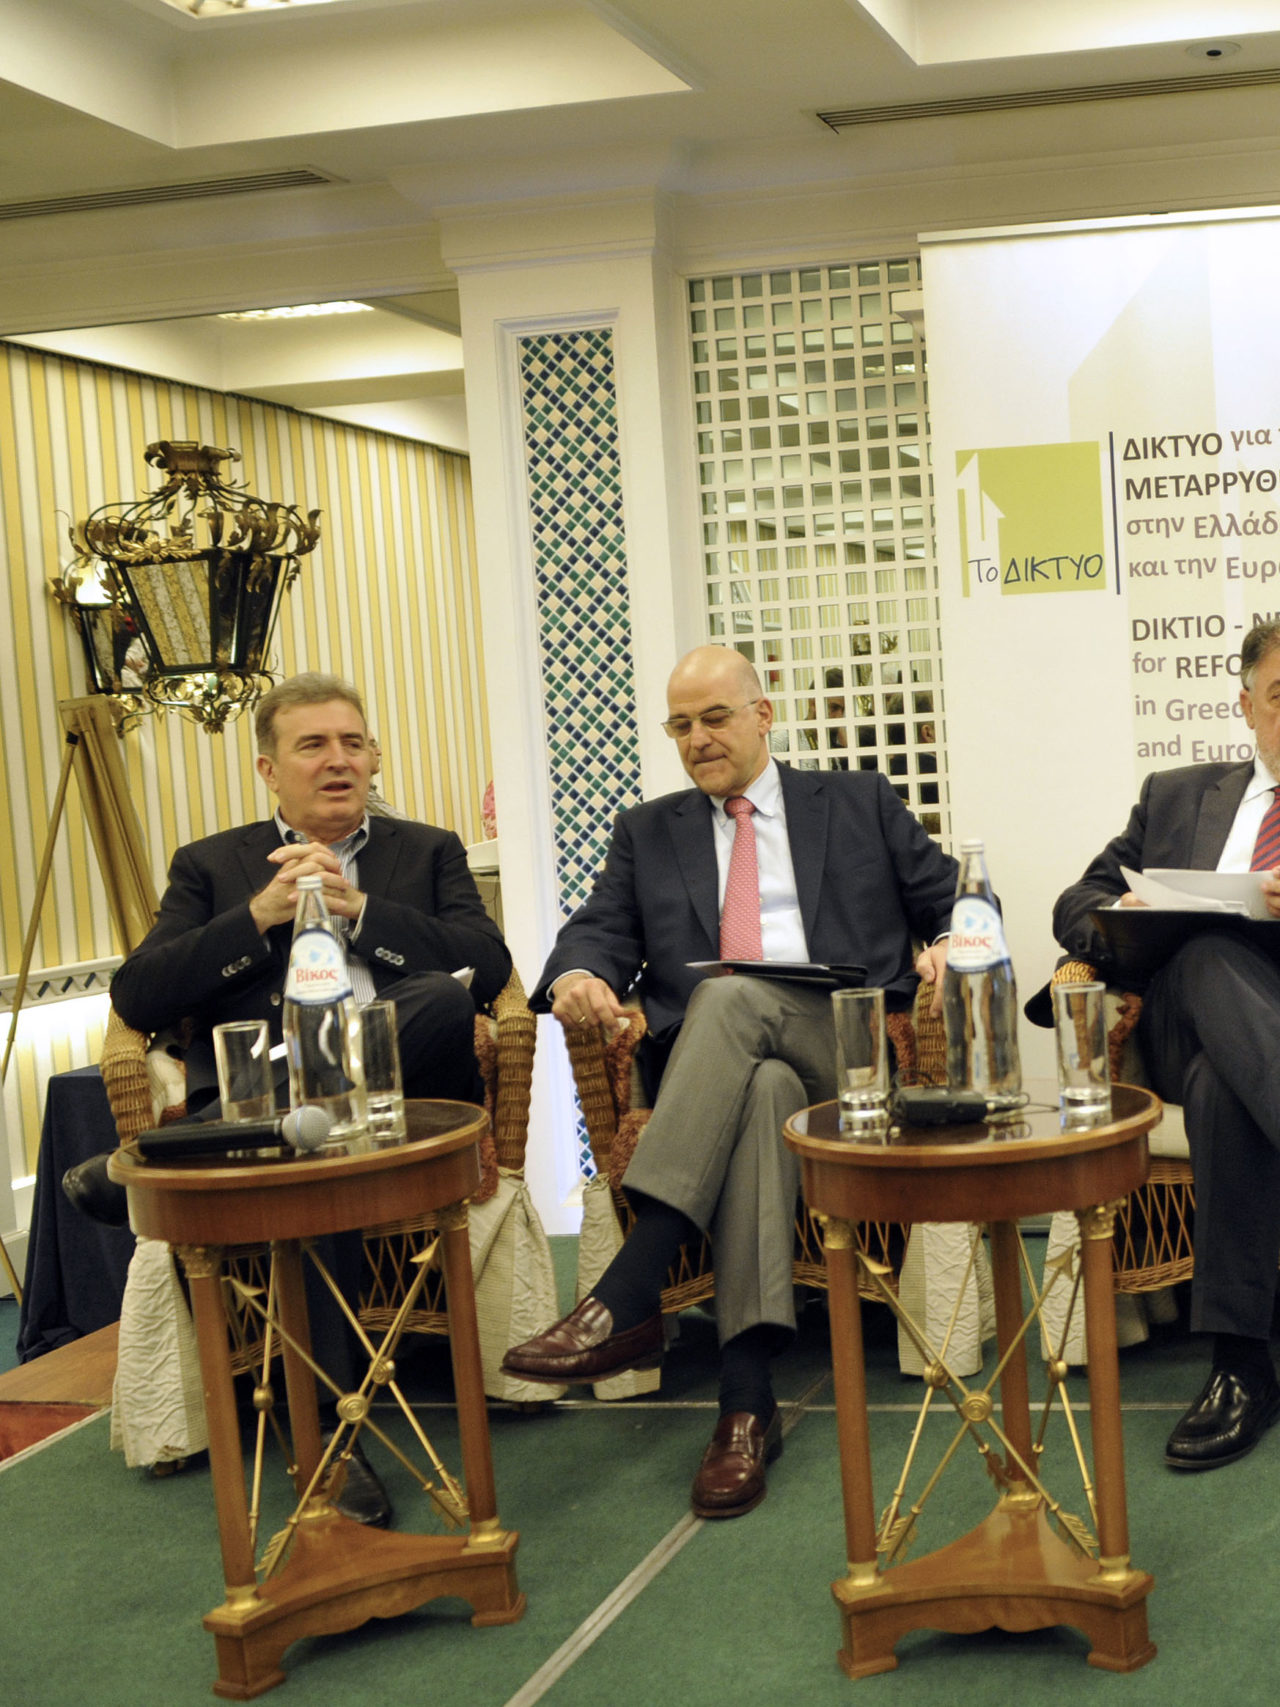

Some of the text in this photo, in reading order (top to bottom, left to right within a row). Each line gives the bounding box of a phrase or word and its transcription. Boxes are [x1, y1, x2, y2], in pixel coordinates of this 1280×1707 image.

[1123, 432, 1223, 461] ΔΙΚΤΥΟ
[1230, 428, 1272, 451] για
[1126, 516, 1185, 539] στην
[1128, 560, 1168, 578] και
[1174, 557, 1217, 579] την
[1131, 614, 1226, 641] DIKTIO
[1132, 651, 1243, 679] for REFO
[1134, 694, 1245, 722] in Greec
[1137, 734, 1254, 763] and Euro
